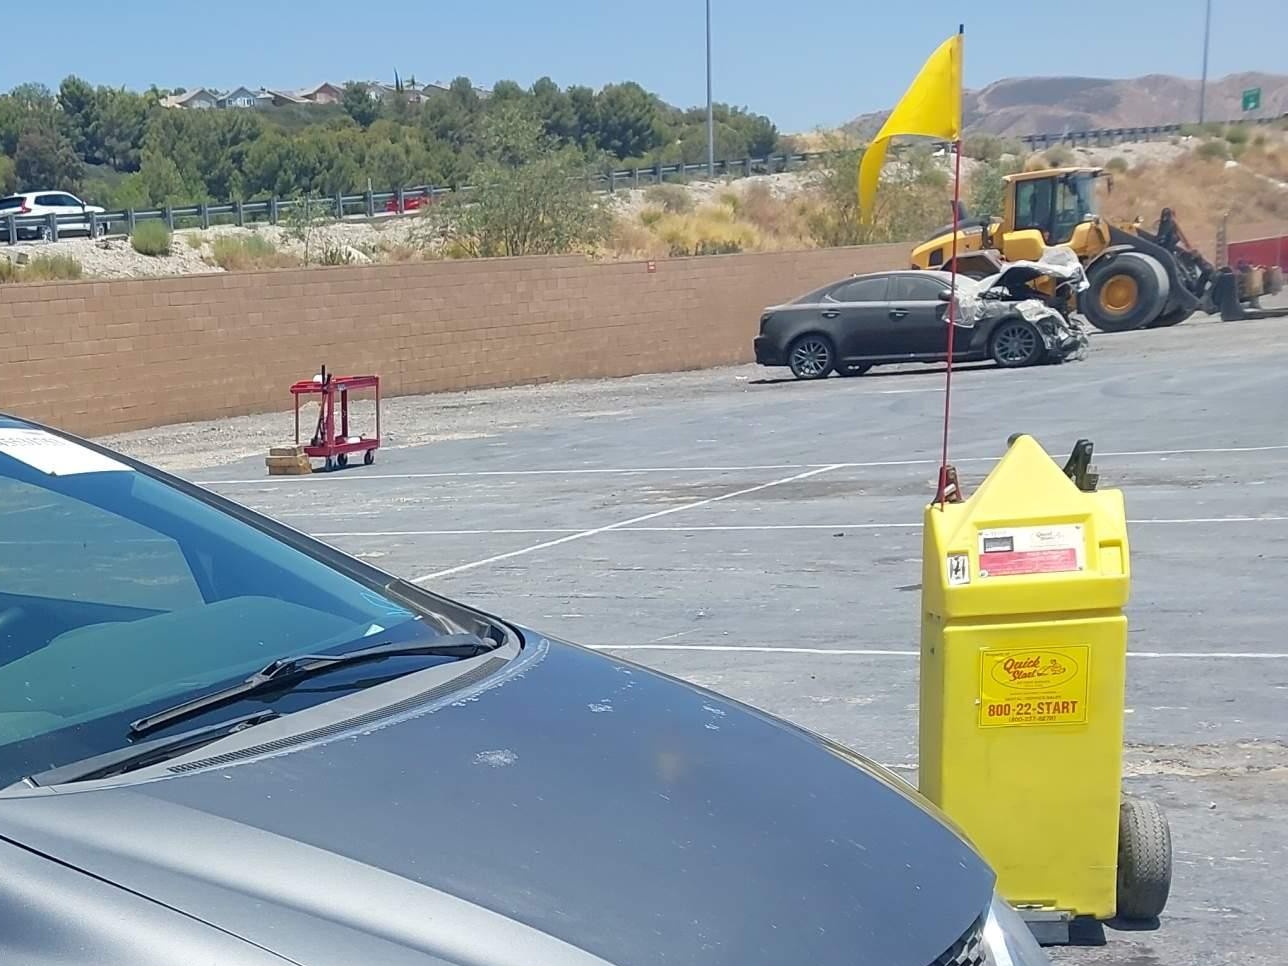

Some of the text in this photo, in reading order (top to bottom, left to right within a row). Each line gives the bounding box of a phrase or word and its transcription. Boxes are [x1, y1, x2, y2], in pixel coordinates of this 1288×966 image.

[1003, 656, 1041, 674] Quick
[1009, 669, 1038, 682] Start
[988, 701, 1079, 717] 800-22-START
